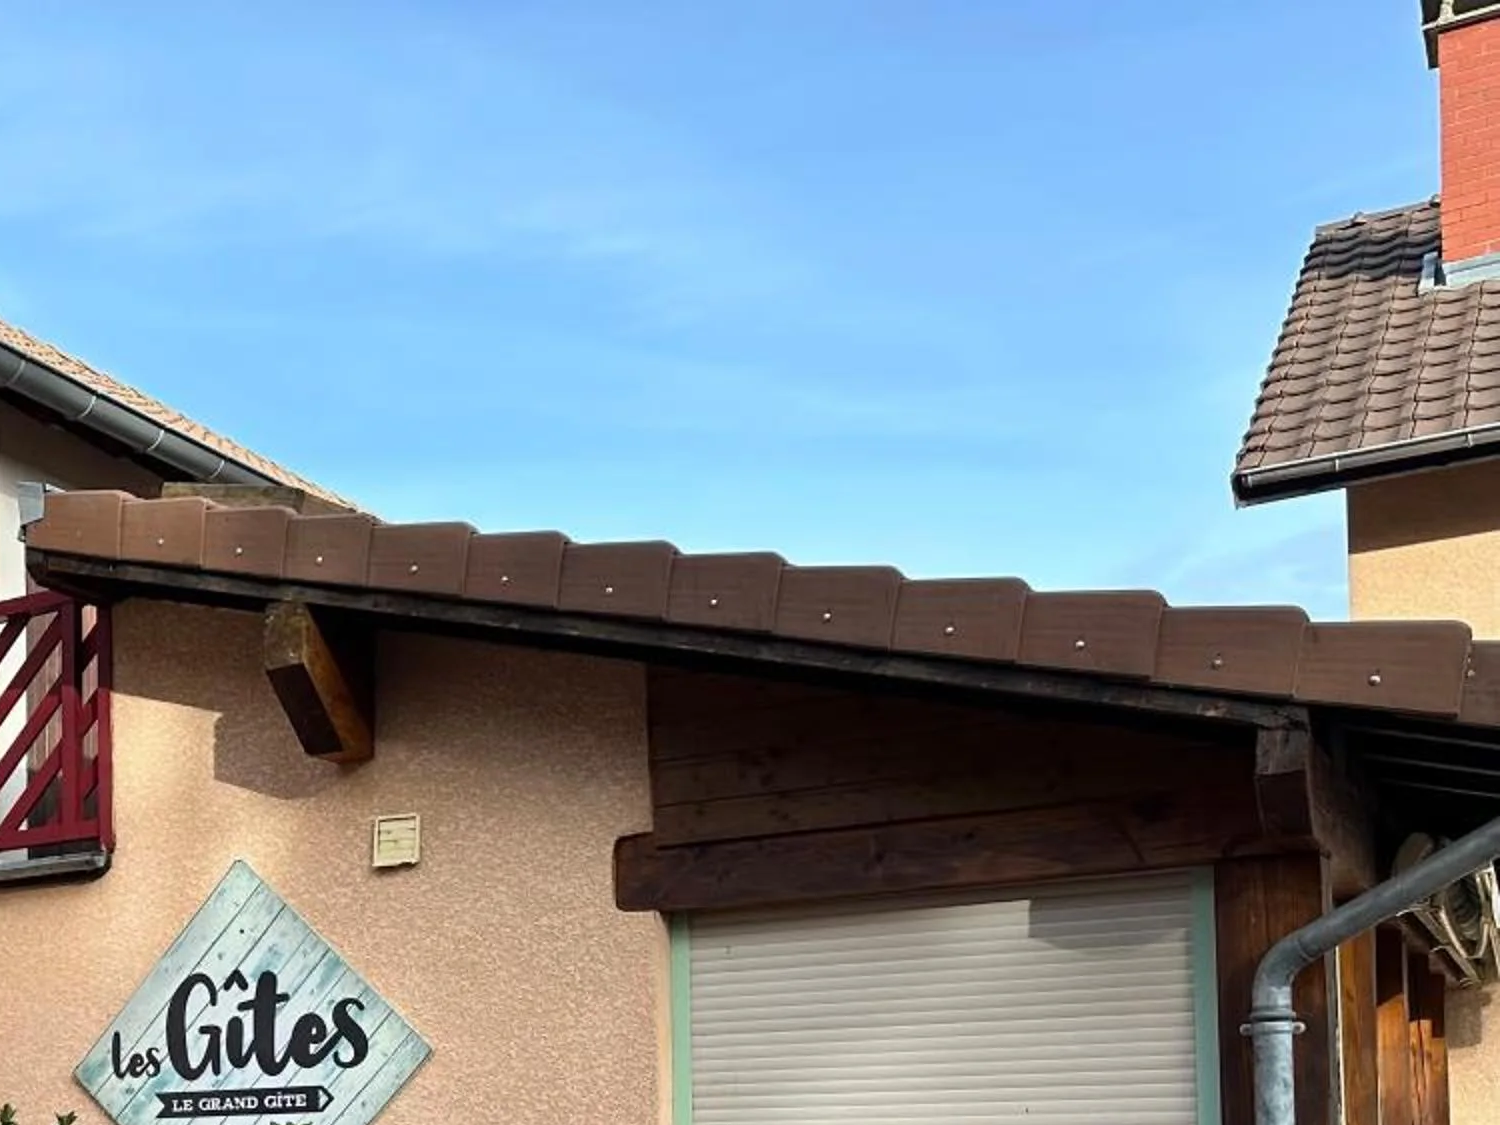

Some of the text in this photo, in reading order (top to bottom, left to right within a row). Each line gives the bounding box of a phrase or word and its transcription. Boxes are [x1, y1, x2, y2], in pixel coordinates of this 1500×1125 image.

[111, 969, 368, 1081] les Gîtes
[173, 1091, 307, 1112] LE GRAND GÎTE
